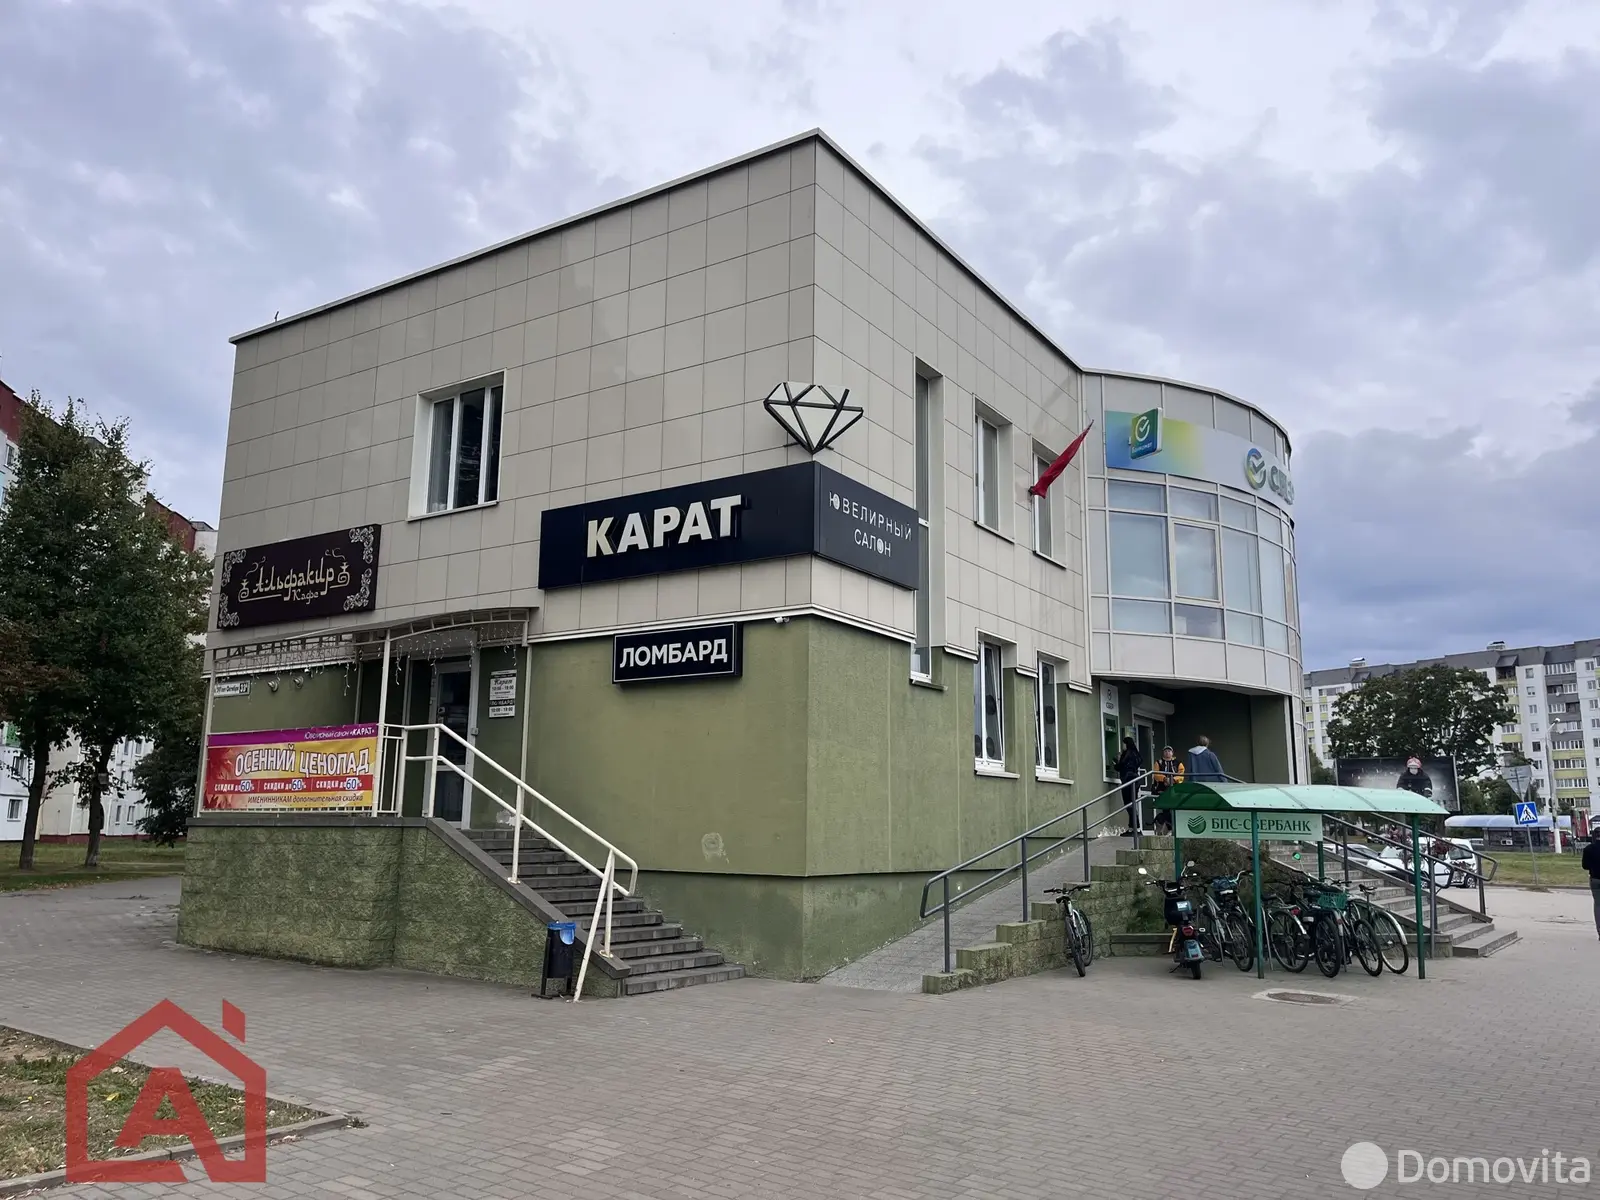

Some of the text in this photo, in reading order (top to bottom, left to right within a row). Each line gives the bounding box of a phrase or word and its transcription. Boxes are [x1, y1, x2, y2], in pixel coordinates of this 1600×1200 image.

[586, 494, 742, 558] КАРАТ
[829, 491, 912, 541] ЮВЕЛИРНЫЙ
[854, 528, 891, 557] САЛОН
[293, 589, 319, 604] Кафе
[619, 637, 728, 668] ЛОМБАРД
[235, 744, 370, 778] ОСЕННИЙ ЦЕНОПАД
[247, 793, 364, 804] ИМЕНИННИКАМ дополнительная скидка
